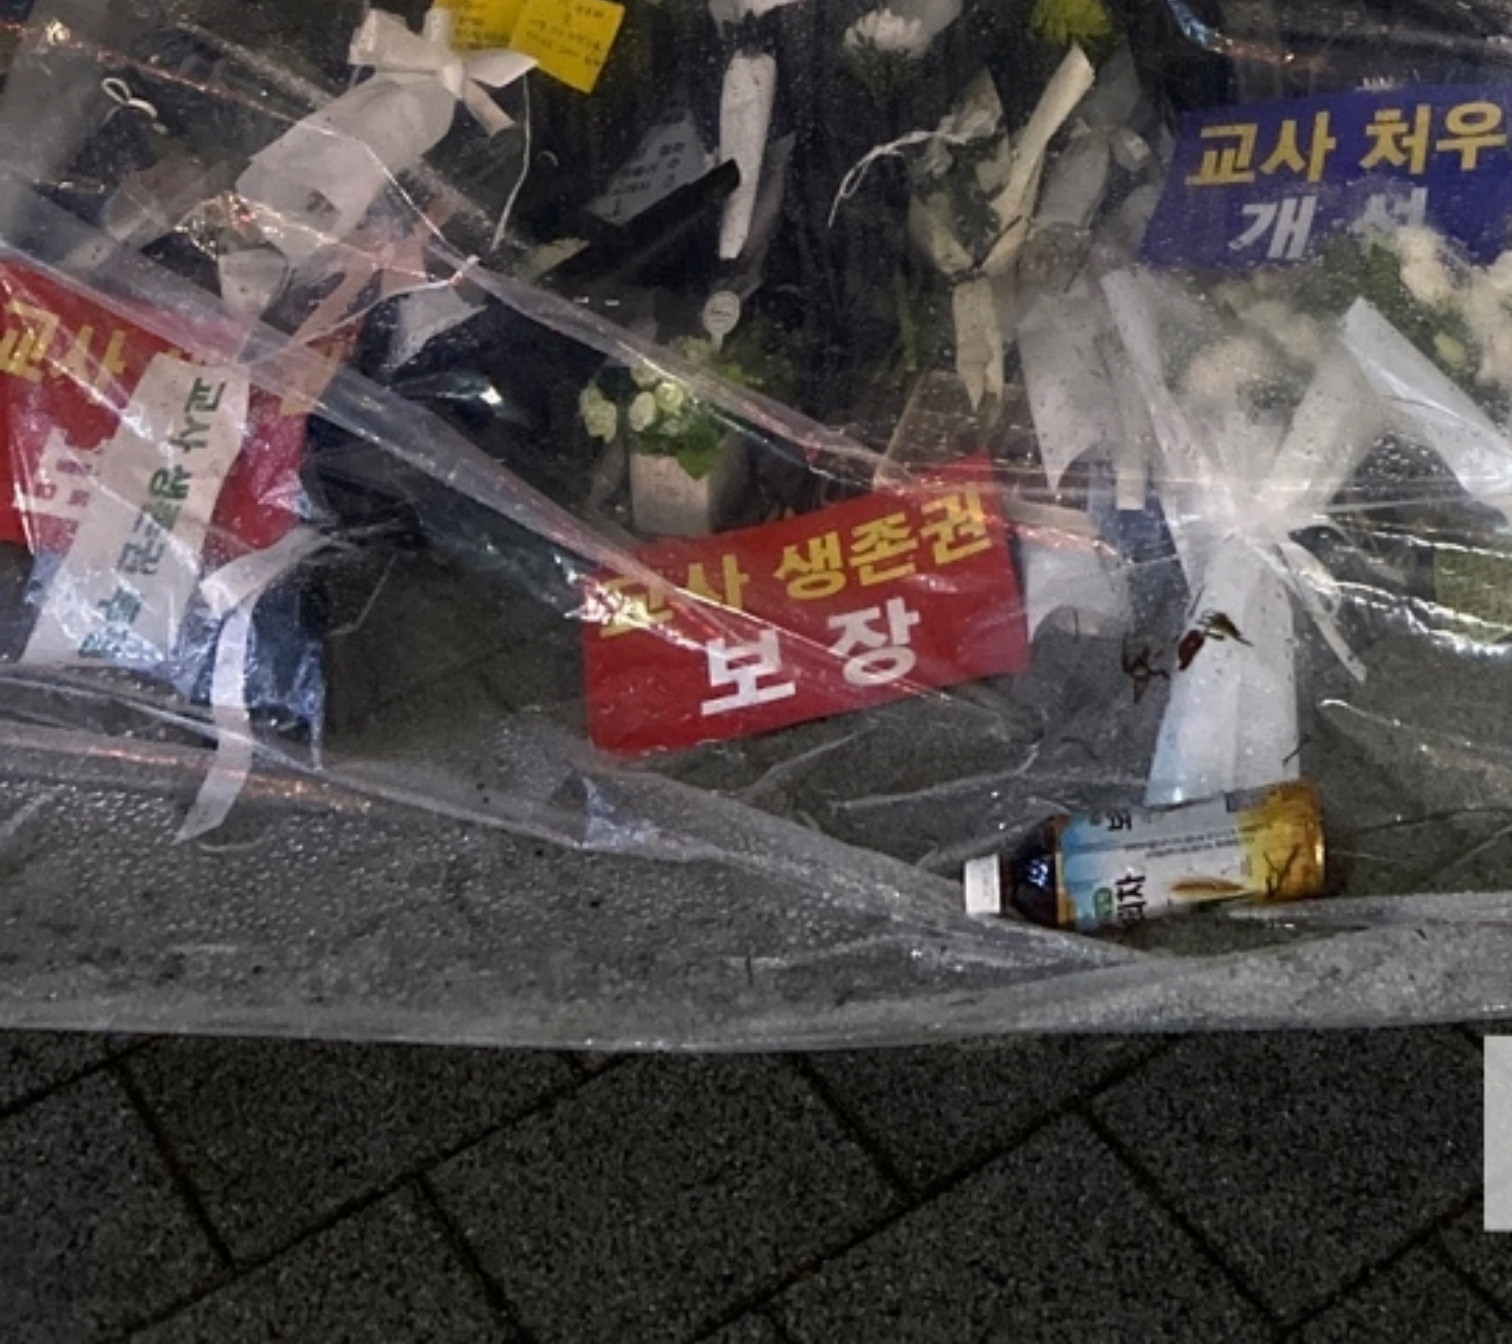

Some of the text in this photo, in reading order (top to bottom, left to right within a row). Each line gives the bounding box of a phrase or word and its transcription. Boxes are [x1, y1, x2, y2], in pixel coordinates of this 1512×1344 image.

[1185, 101, 1508, 185] 교사 처우
[774, 489, 992, 601] 생존권
[702, 597, 920, 716] 보장
